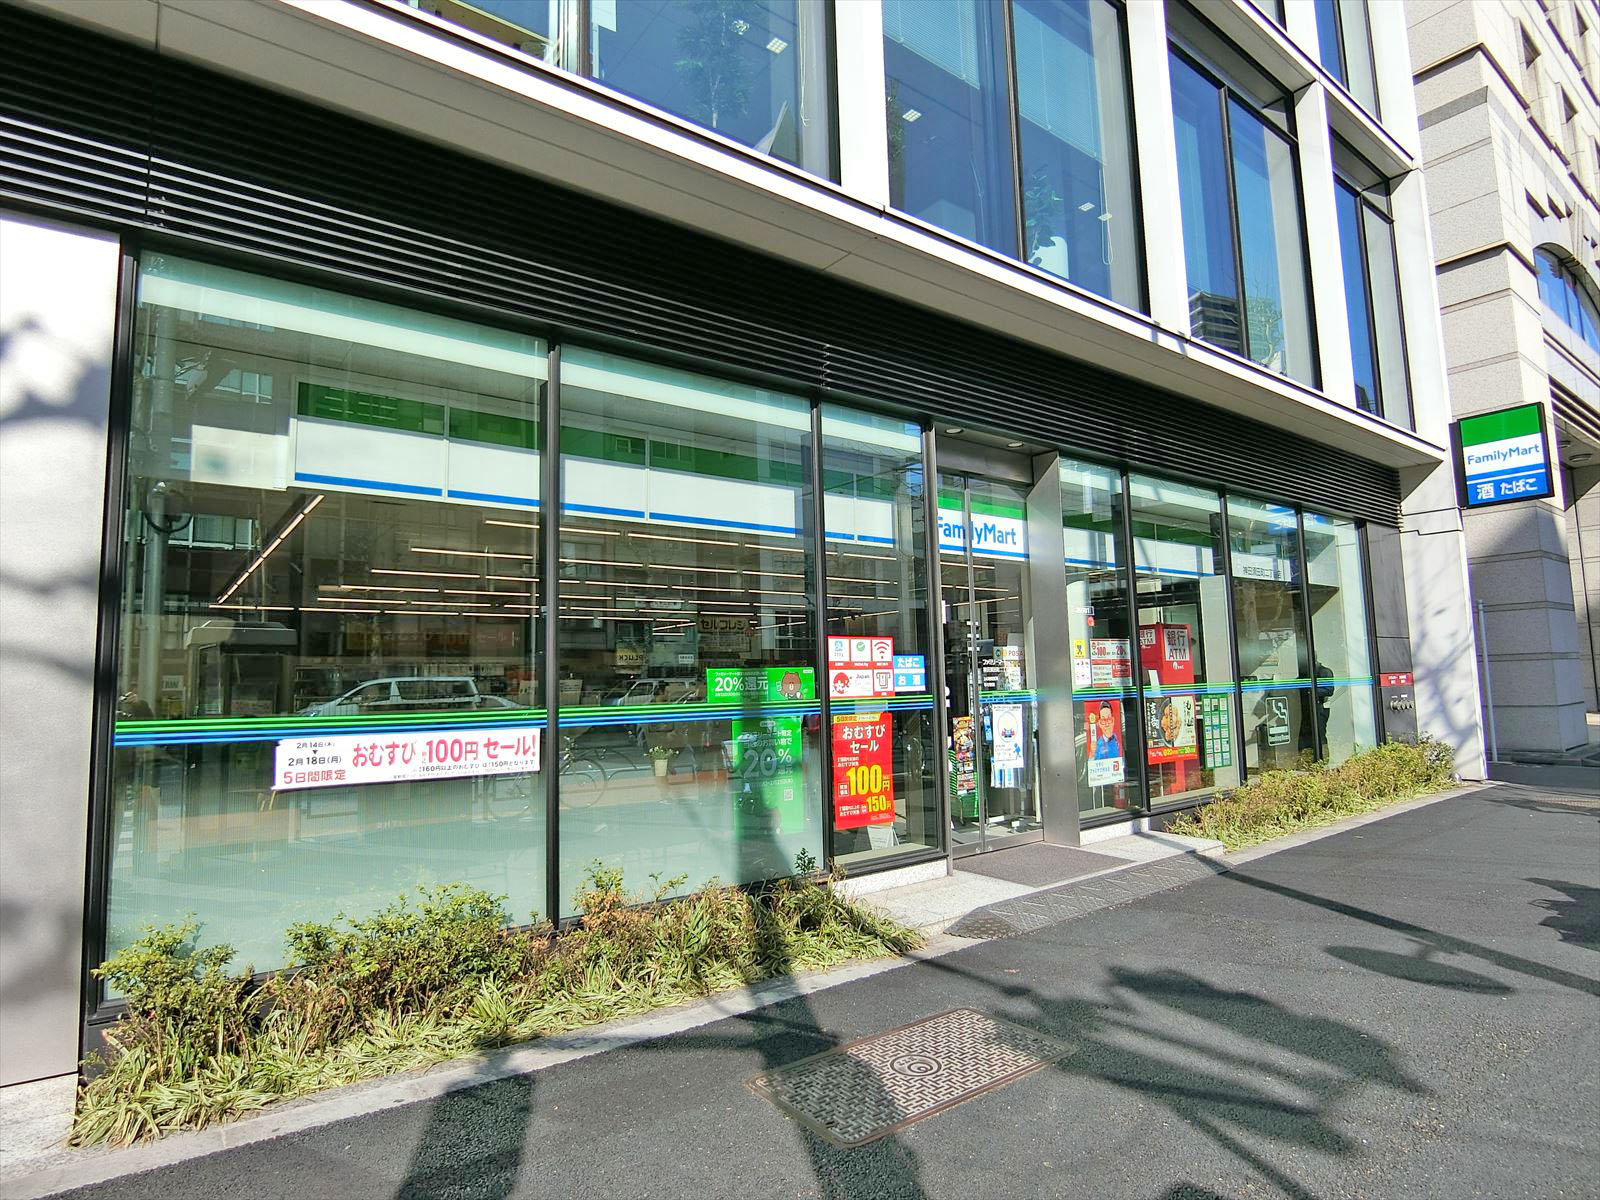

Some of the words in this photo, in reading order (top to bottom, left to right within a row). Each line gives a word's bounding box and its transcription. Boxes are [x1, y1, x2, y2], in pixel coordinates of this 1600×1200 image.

[1467, 444, 1540, 465] FamilyMart
[1476, 482, 1495, 499] 酒
[1500, 478, 1538, 495] たばこ
[937, 516, 1016, 546] amlyMart
[1167, 630, 1186, 646] 銀行
[1168, 648, 1188, 660] ATM
[896, 657, 921, 668] たばこ
[842, 723, 886, 740] おむすび
[352, 740, 417, 768] おむすび
[849, 739, 880, 754] セール
[283, 769, 347, 785] 5日間限定
